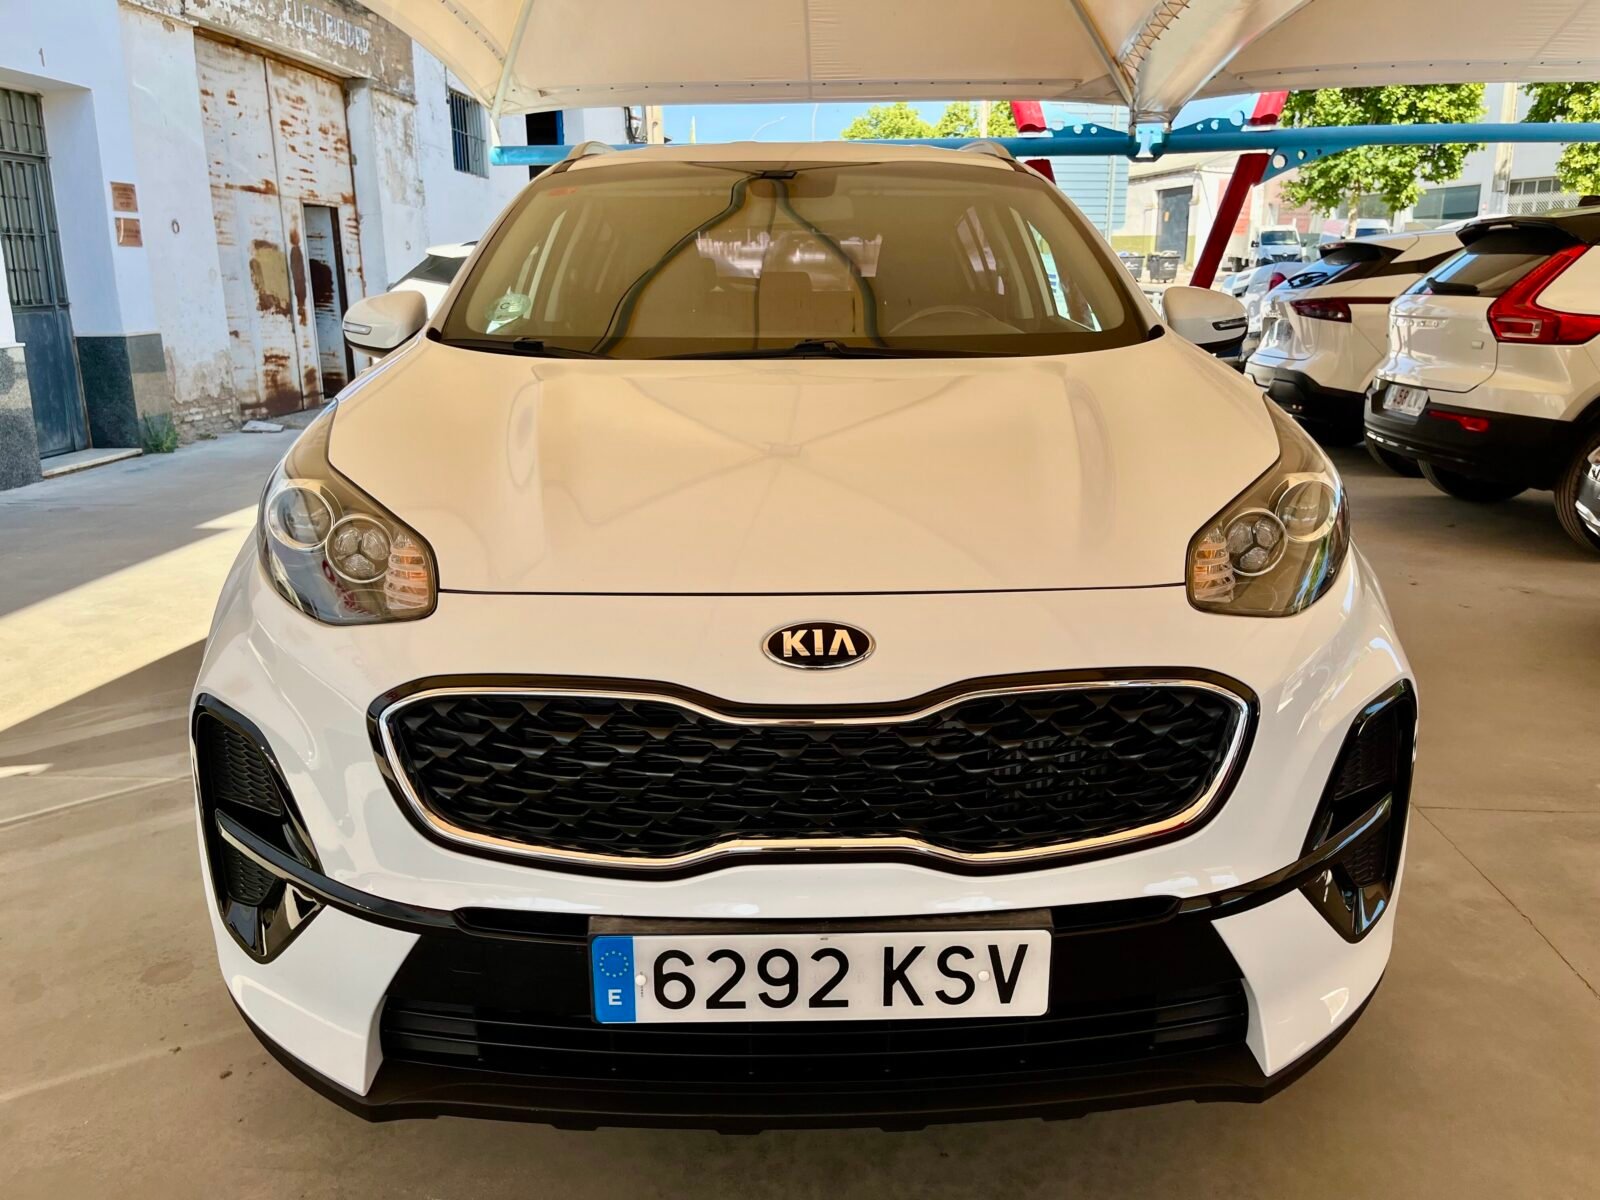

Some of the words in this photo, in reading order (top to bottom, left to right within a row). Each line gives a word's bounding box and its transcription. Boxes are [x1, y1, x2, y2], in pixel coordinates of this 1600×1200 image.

[781, 628, 858, 658] KIA
[653, 947, 850, 1010] 6292
[881, 943, 1029, 1007] KSV
[607, 988, 623, 1006] E
